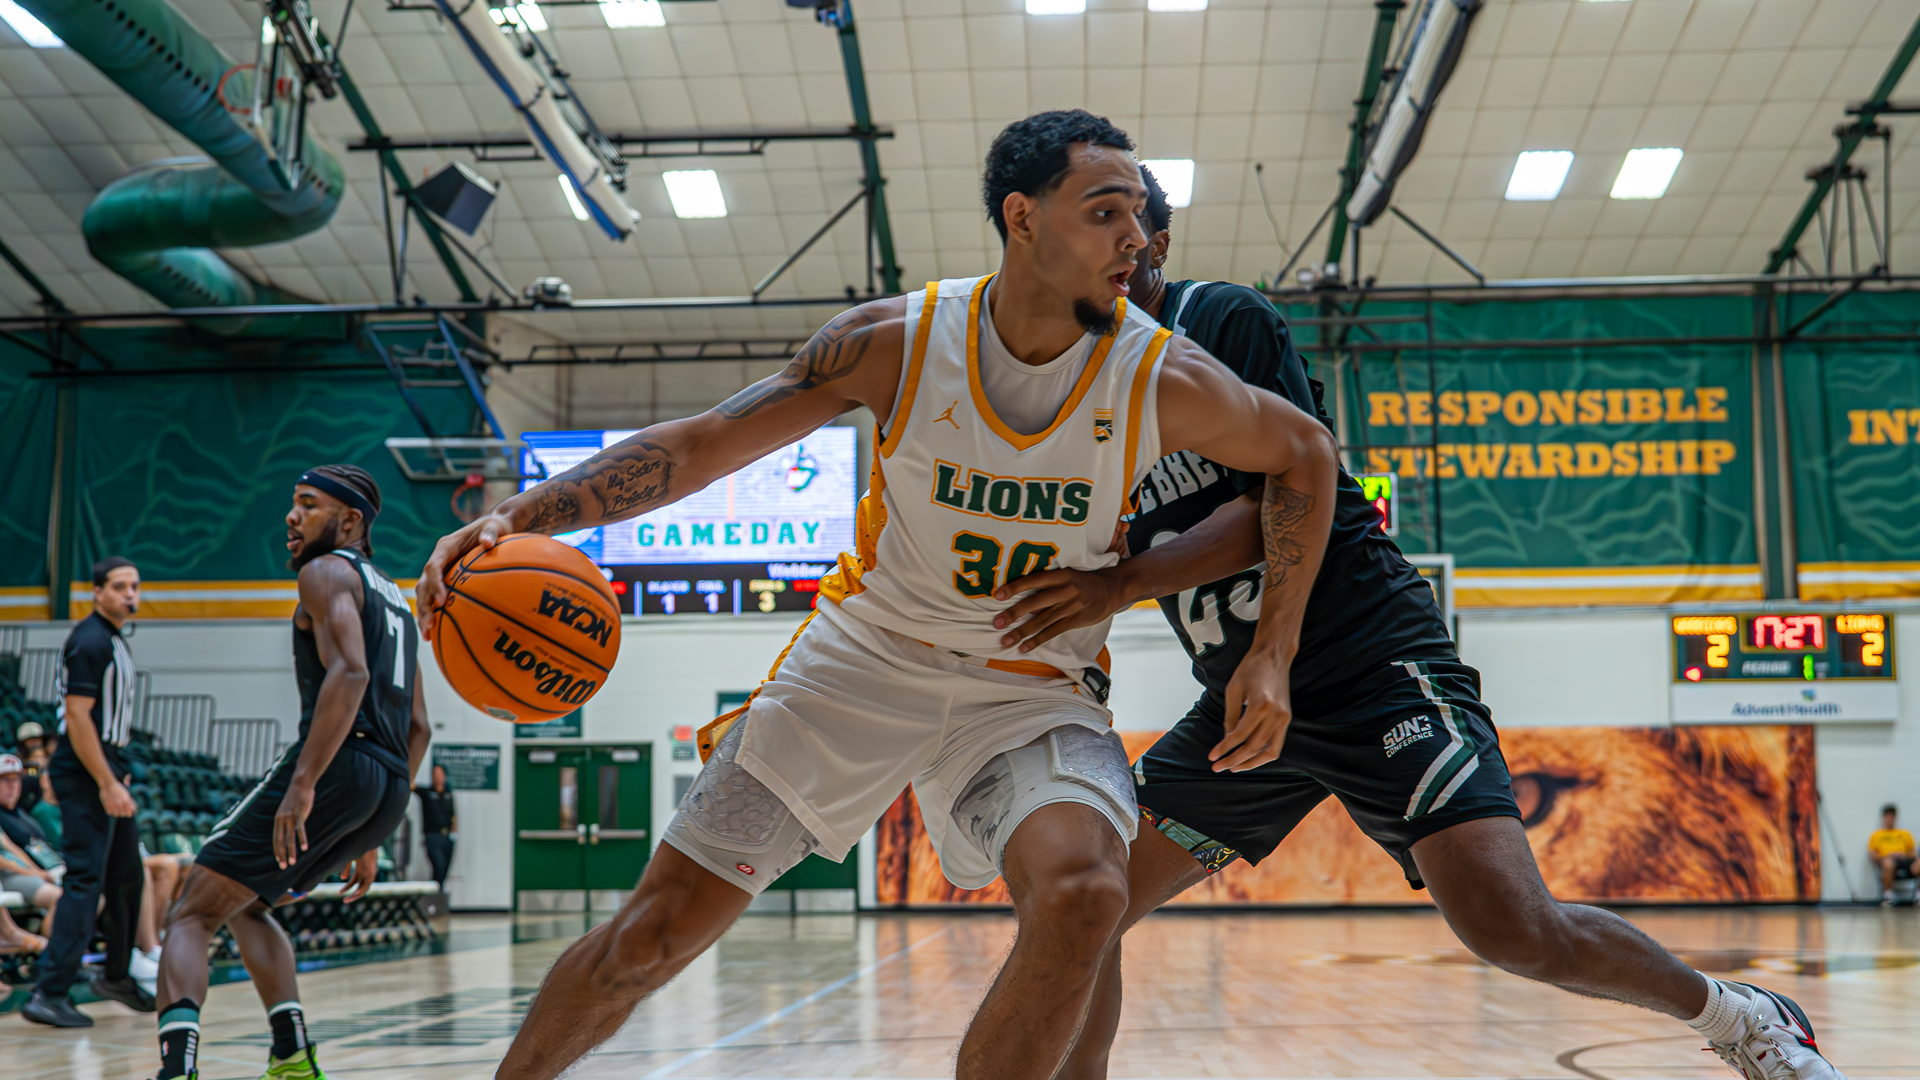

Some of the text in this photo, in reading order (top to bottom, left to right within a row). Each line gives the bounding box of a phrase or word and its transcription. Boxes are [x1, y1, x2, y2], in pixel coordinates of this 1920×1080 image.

[1367, 388, 1728, 427] RESPONSIBLE
[1366, 440, 1737, 479] STEWARDSHIP
[930, 458, 1094, 527] LIONS
[637, 521, 820, 546] GAMEDAY
[537, 589, 615, 649] NCAA
[660, 592, 719, 614] 1 1
[758, 591, 776, 613] 3
[384, 606, 406, 690] 7
[1706, 634, 1730, 668] 2
[1861, 632, 1885, 667] 2
[493, 630, 598, 706] Wilson
[1382, 716, 1423, 750] SUN
[1385, 730, 1435, 759] CONFERENCE
